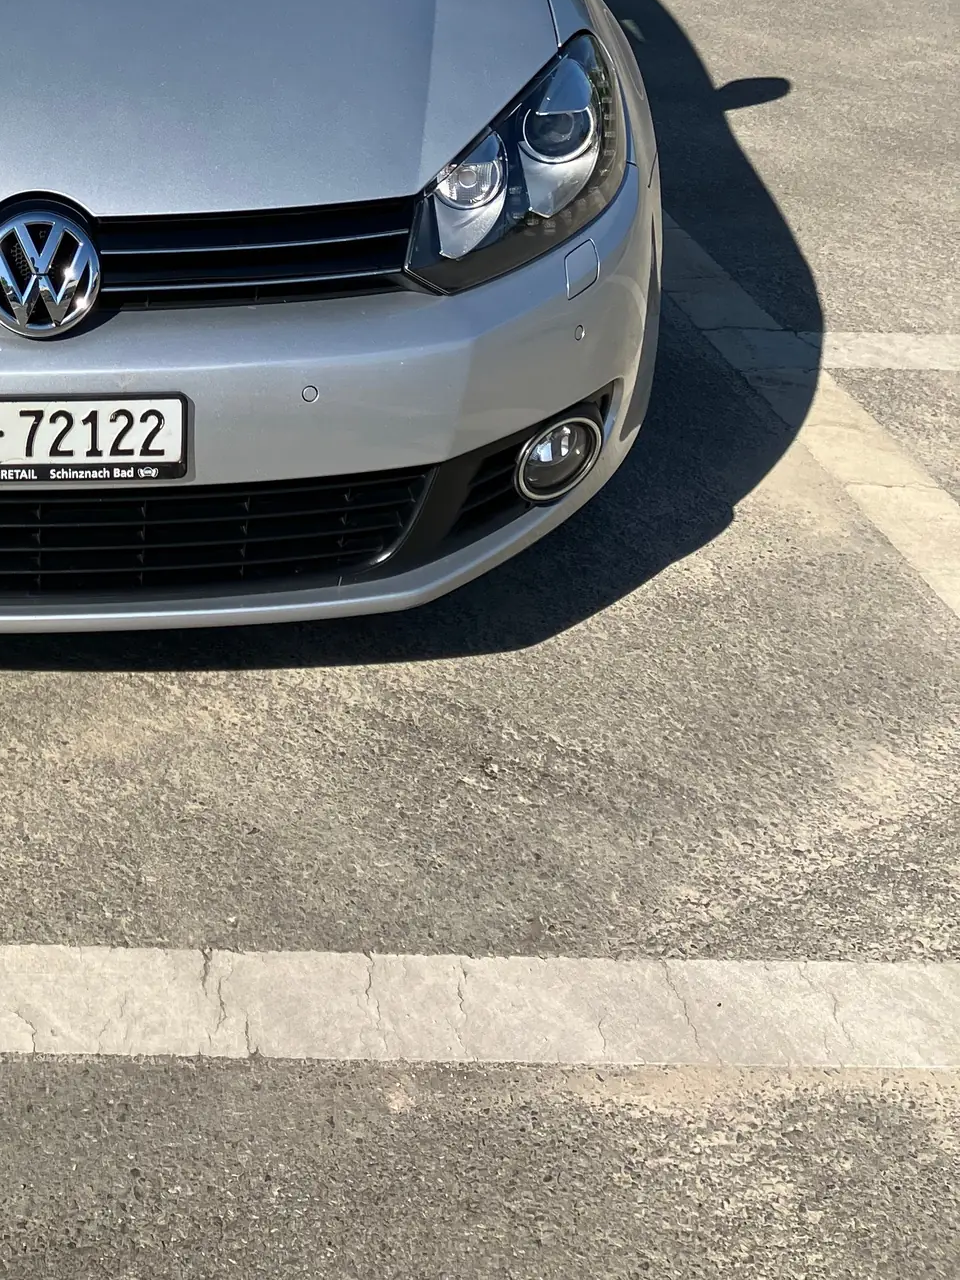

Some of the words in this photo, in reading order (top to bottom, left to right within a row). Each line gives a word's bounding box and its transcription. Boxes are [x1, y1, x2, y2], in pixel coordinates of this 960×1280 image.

[0, 469, 38, 480] RETAIL
[49, 468, 112, 479] Schinznach
[113, 467, 134, 478] Bad
